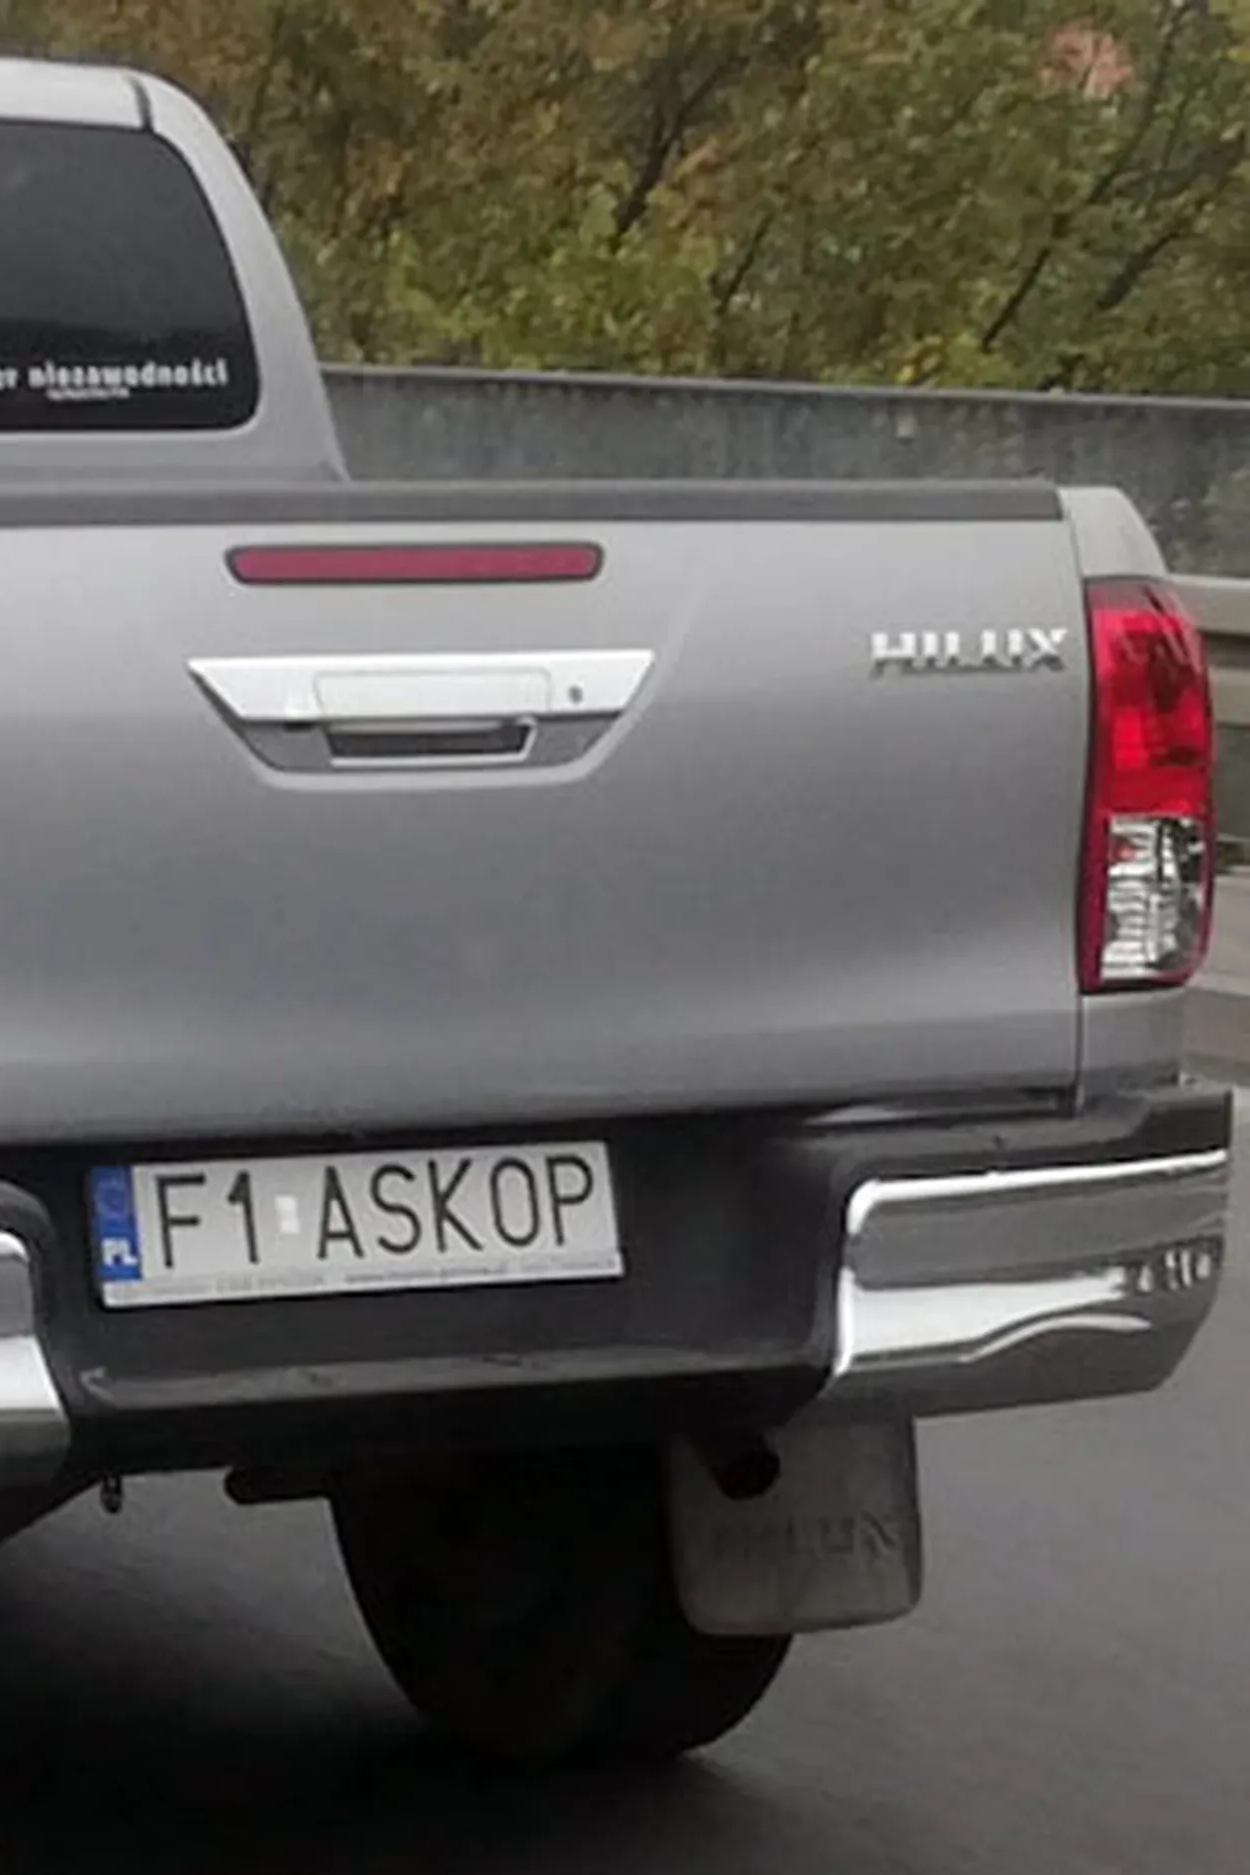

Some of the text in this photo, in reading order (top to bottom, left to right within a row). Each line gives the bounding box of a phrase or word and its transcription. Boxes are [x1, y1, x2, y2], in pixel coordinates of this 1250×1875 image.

[868, 628, 1068, 676] HILUX
[155, 1170, 259, 1268] F1
[316, 1153, 595, 1260] ASKOP
